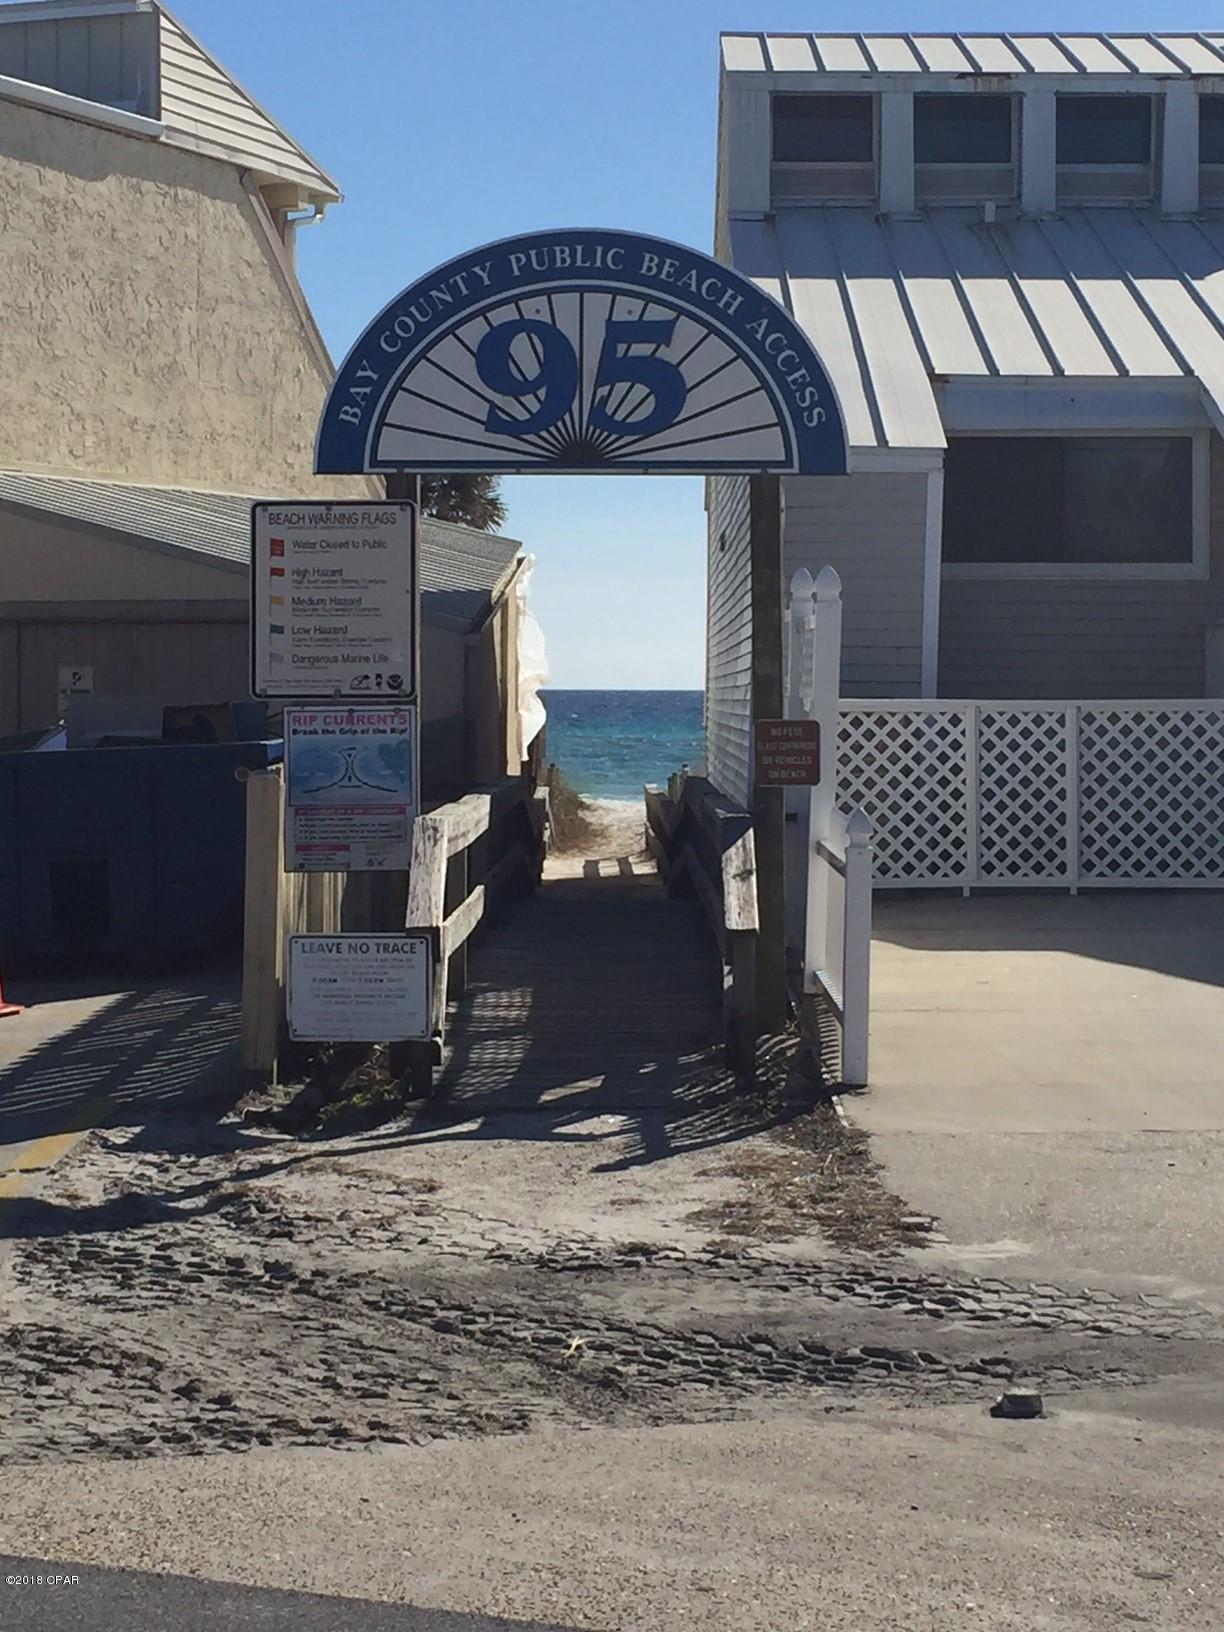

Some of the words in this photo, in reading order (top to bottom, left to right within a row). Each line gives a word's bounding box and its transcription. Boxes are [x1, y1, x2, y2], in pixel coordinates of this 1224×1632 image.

[339, 360, 379, 426] BAY
[380, 261, 493, 353] COUNTY
[508, 244, 625, 276] PUBLIC
[639, 252, 744, 317] BEACH
[745, 317, 826, 428] ACCESS
[475, 318, 687, 436] 95
[268, 512, 305, 526] BEACH
[308, 512, 359, 525] WARNING
[361, 511, 397, 525] FLAGS
[292, 540, 316, 549] Water
[320, 540, 349, 549] Closed
[352, 540, 360, 549] to
[362, 540, 387, 549] Public
[291, 568, 310, 580] High
[312, 567, 343, 577] Hazard
[291, 596, 327, 606] Medium
[330, 596, 362, 606] Hazard
[291, 625, 310, 635] Low
[314, 625, 348, 635] Hazard
[291, 654, 339, 665] Dangerous
[341, 654, 371, 664] Marine
[373, 654, 389, 664] Life
[291, 714, 317, 726] RIP
[323, 713, 408, 726] CURRENTS
[292, 728, 319, 736] Break
[339, 728, 358, 736] Grip
[360, 727, 370, 735] of
[372, 727, 388, 735] the
[780, 769, 807, 779] BEACH
[301, 942, 343, 954] LEAVE
[347, 942, 370, 954] NO
[374, 942, 417, 954] TRACE
